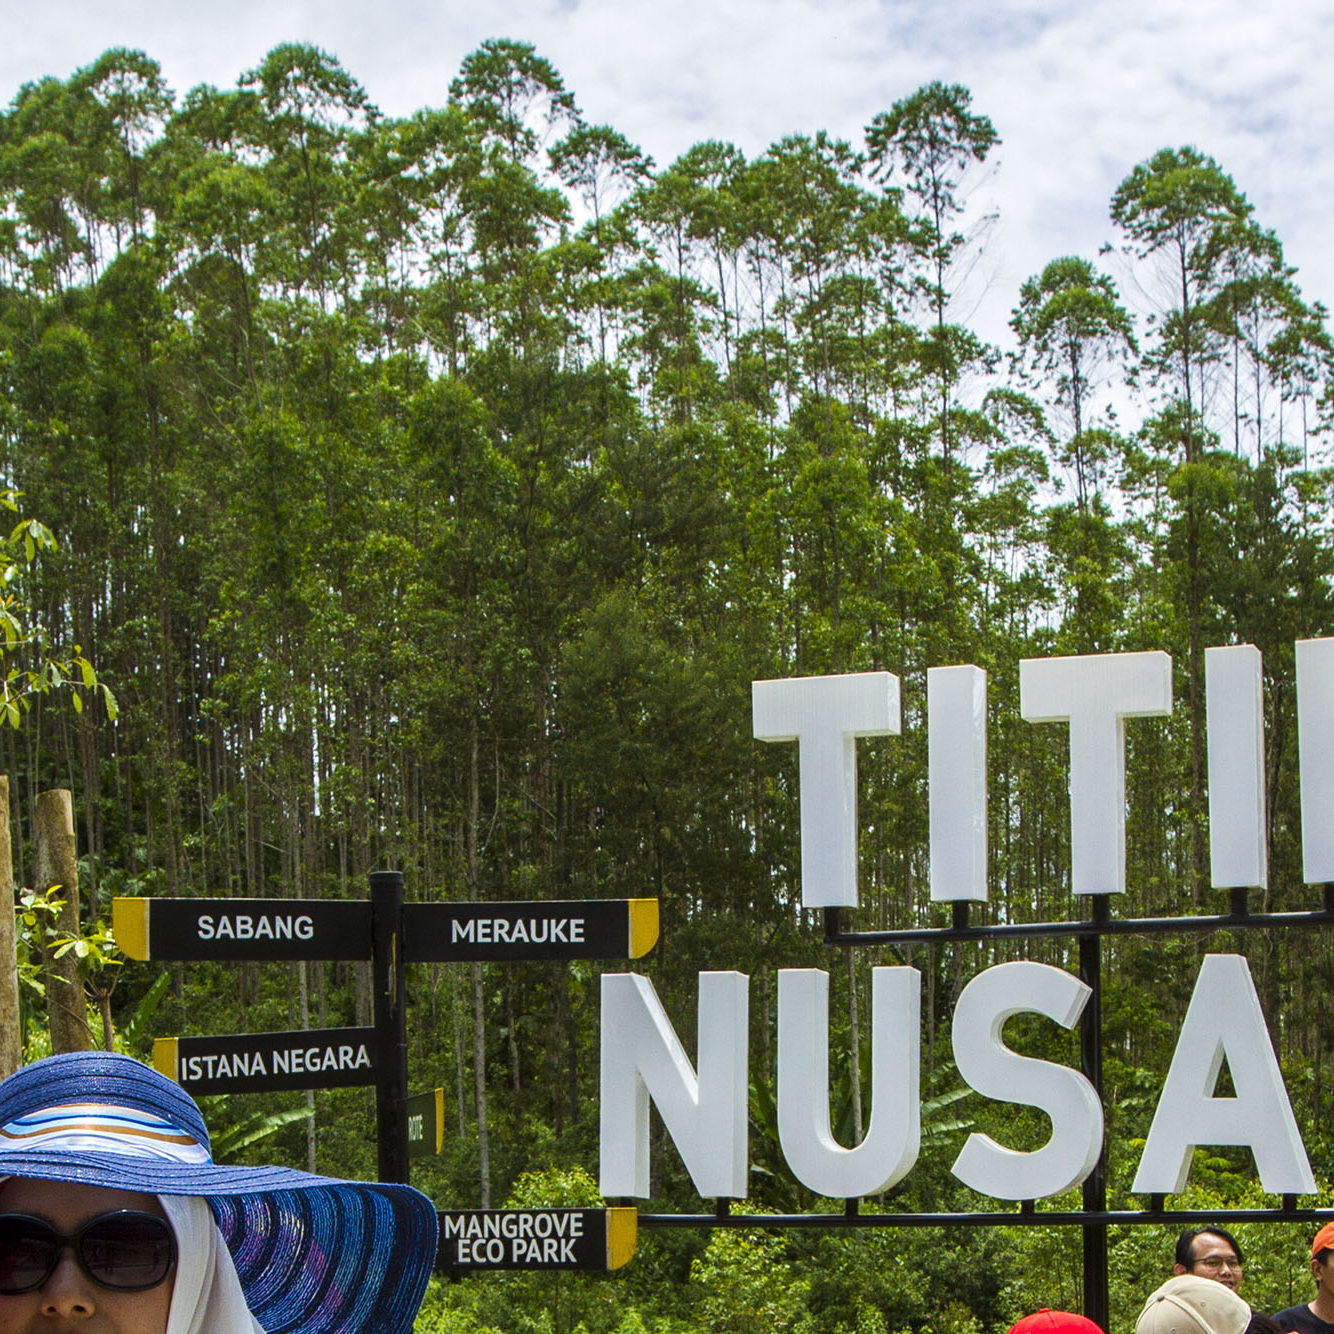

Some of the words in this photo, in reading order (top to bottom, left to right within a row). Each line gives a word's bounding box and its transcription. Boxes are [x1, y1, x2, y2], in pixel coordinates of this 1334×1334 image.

[197, 914, 315, 940] SABANG
[451, 918, 586, 943] MERAUKE
[180, 1051, 268, 1082] ISTANA
[272, 1044, 373, 1075] NEGARA
[444, 1212, 584, 1239] MANGROVE
[457, 1238, 505, 1264] ECO
[511, 1237, 578, 1264] PARK
